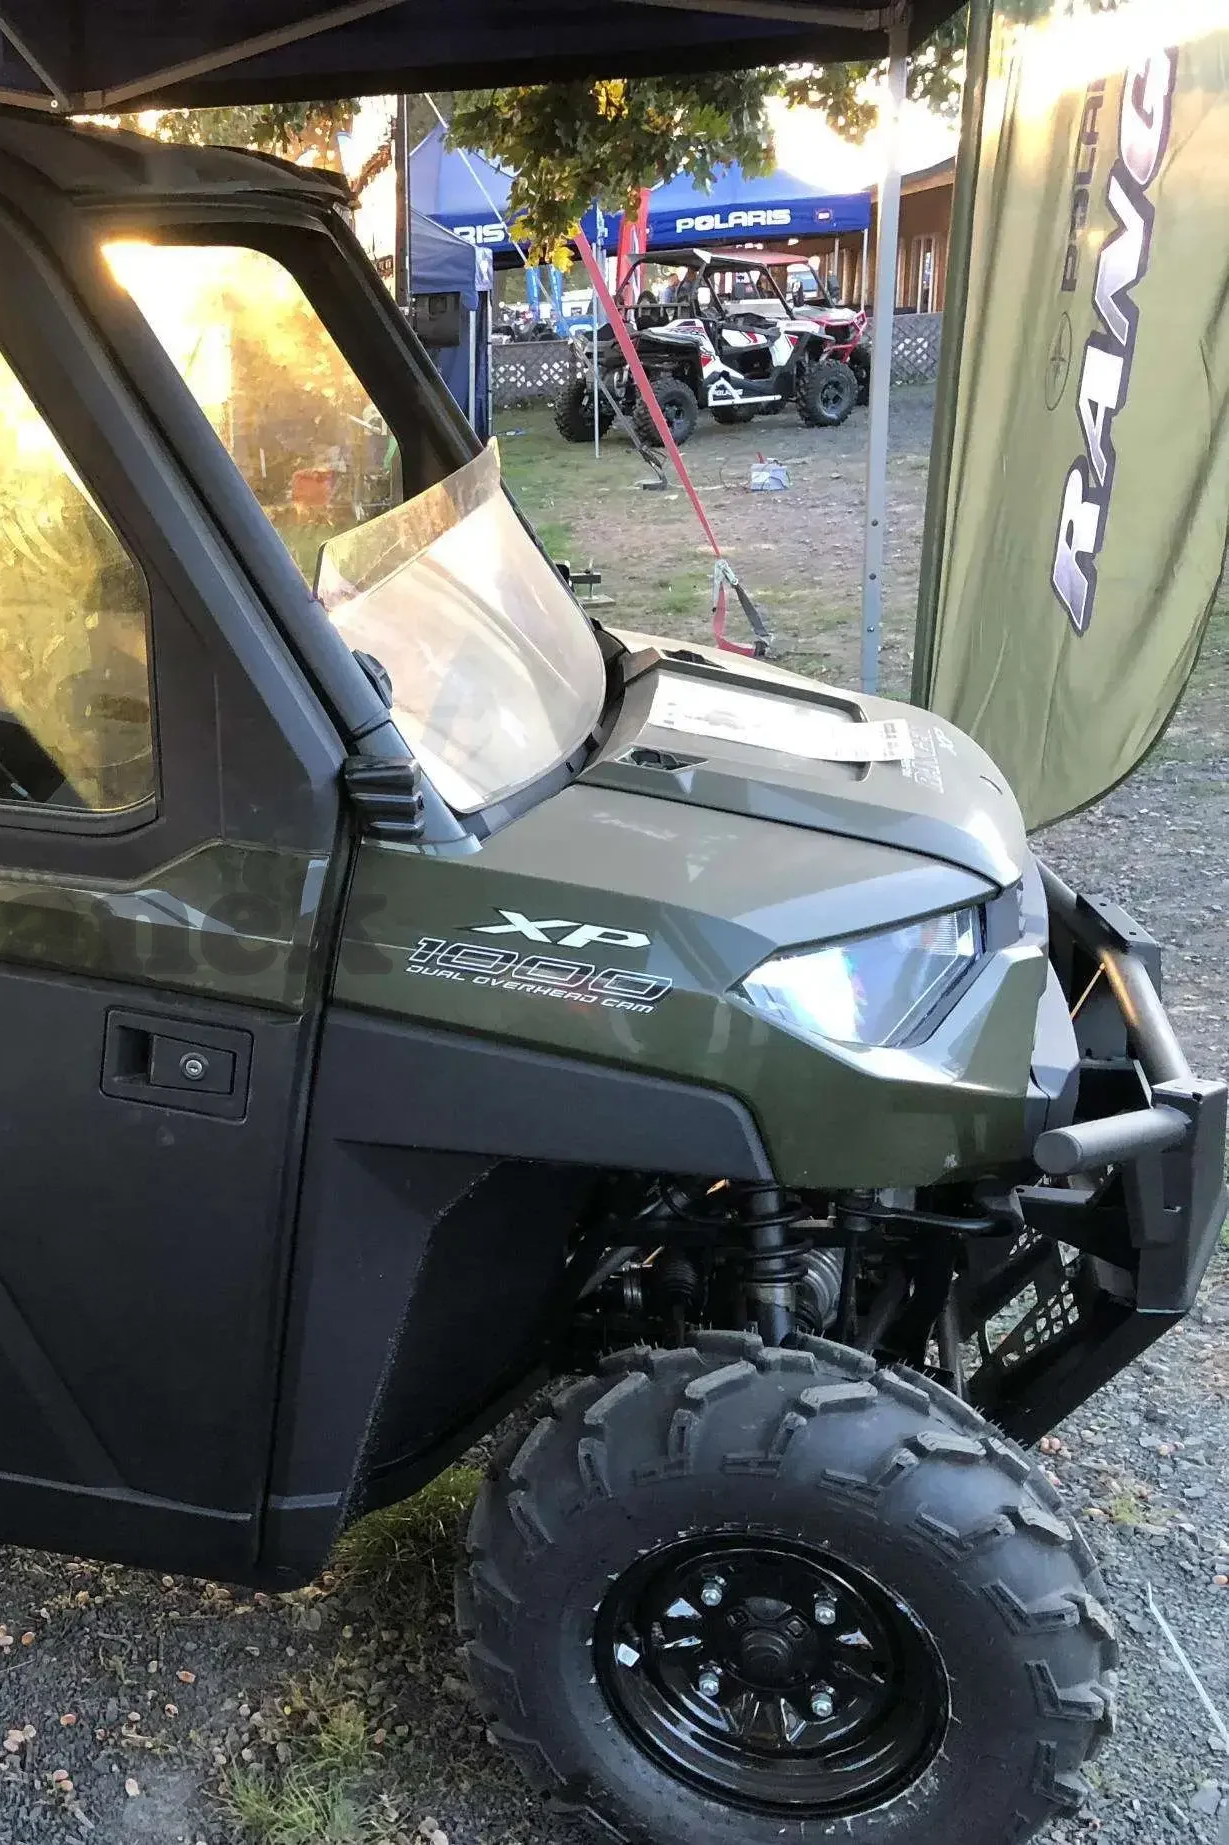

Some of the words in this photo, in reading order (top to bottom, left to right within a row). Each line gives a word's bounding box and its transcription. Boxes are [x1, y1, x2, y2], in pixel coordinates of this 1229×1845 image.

[1060, 77, 1107, 292] POLA
[452, 223, 506, 244] RIS
[675, 208, 792, 233] POLARIS
[455, 907, 653, 949] XP
[405, 964, 466, 982] DUAL
[472, 974, 597, 1005] OVERHEAD
[600, 996, 656, 1014] CAM
[407, 936, 674, 1002] 1000
